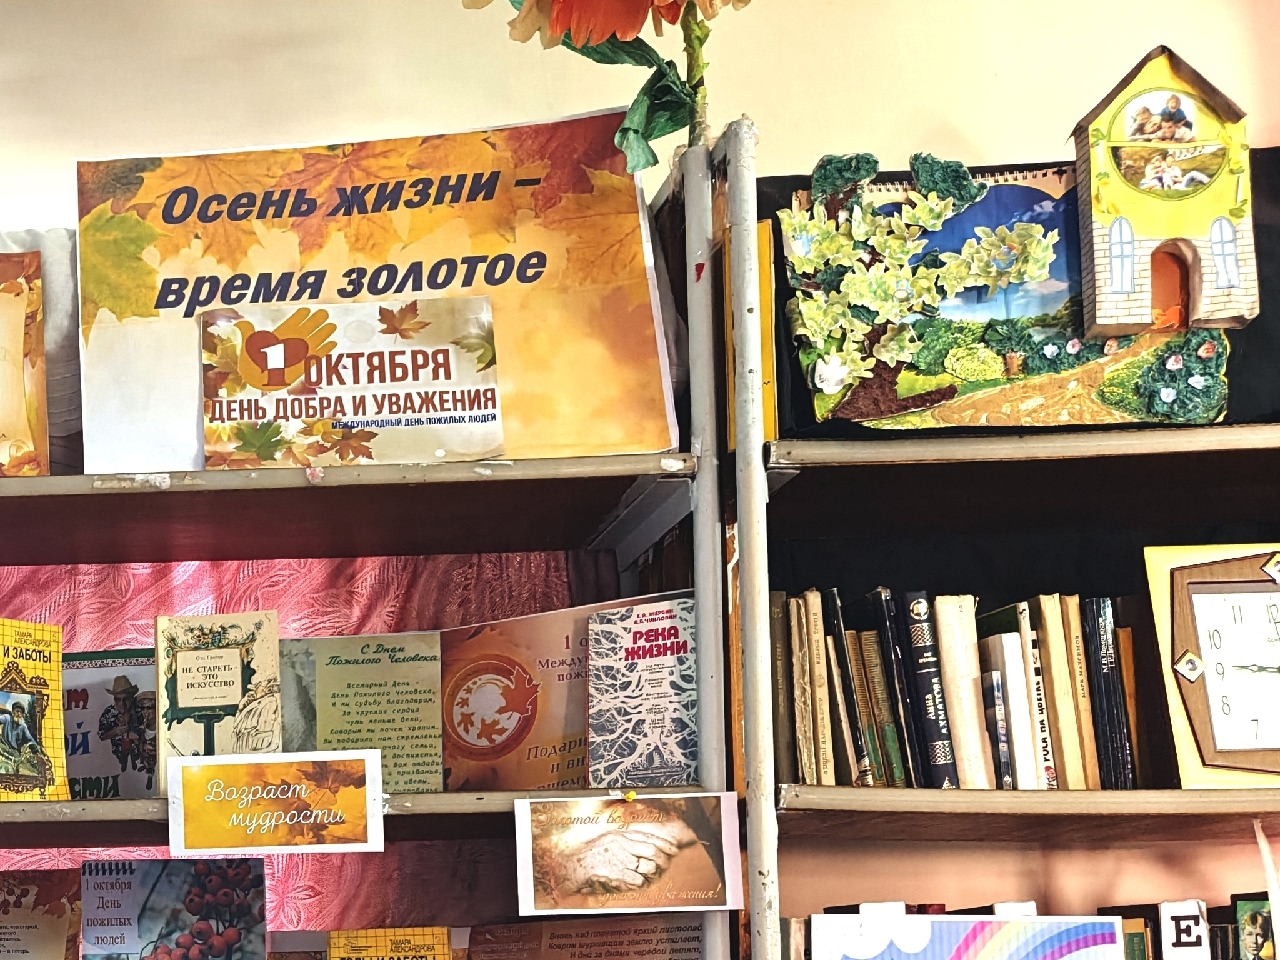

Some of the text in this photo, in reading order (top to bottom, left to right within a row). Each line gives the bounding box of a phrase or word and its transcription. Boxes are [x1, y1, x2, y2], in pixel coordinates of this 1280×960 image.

[162, 170, 501, 226] Осень жизни
[154, 250, 547, 318] время золотое
[259, 342, 452, 389] 1 ОКТЯБРЯ
[210, 388, 497, 424] ДЕНЬ ДОБРА И УВАЖЕНИЯ
[331, 411, 497, 430] МЕЖДУНАРОДНЫЙ ДЕНЬ ПОЖИЛЫХ ЛЮДЕЙ
[564, 635, 570, 649] 1
[633, 626, 679, 644] РЕКА
[4, 646, 10, 658] И
[12, 647, 51, 664] ЗАБОТЫ
[361, 644, 405, 654] С Днем
[624, 640, 688, 661] ЖИЗНИ
[326, 654, 438, 666] Пожилого Человека
[187, 680, 234, 689] ИСКУССТВО
[925, 693, 936, 720] Анна
[932, 677, 948, 734] АХМАТОВА
[204, 779, 311, 808] Возраст
[229, 806, 346, 834] мудрости
[86, 879, 132, 896] 1 октября
[97, 897, 121, 910] День
[86, 916, 132, 927] пожилых
[94, 934, 126, 945] людей
[1170, 915, 1203, 948] Е
[389, 945, 435, 953] АЛЕКСАНДРОВА
